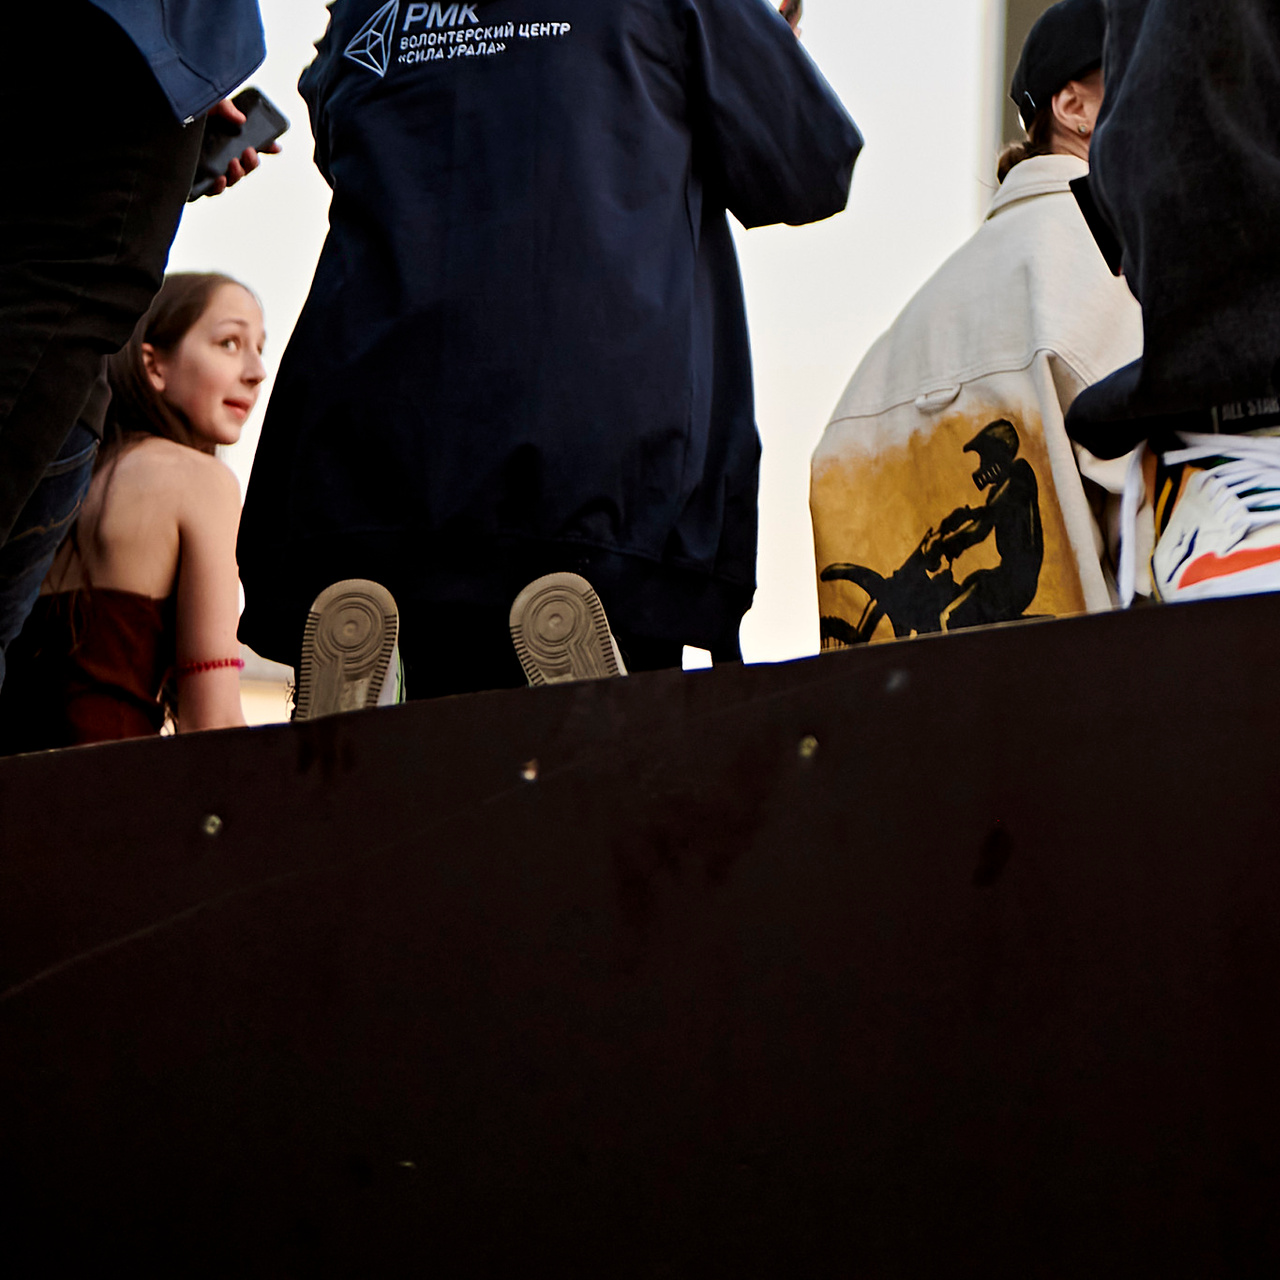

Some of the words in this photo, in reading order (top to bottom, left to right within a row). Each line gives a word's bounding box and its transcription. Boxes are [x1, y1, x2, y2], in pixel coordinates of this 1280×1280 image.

[402, 1, 480, 32] РМК
[400, 21, 515, 51] ВОЛОНТЕРСКИЙ
[518, 22, 571, 39] ЦЕНТР
[398, 47, 445, 64] «СИЛА
[447, 41, 506, 60] УРАЛА»
